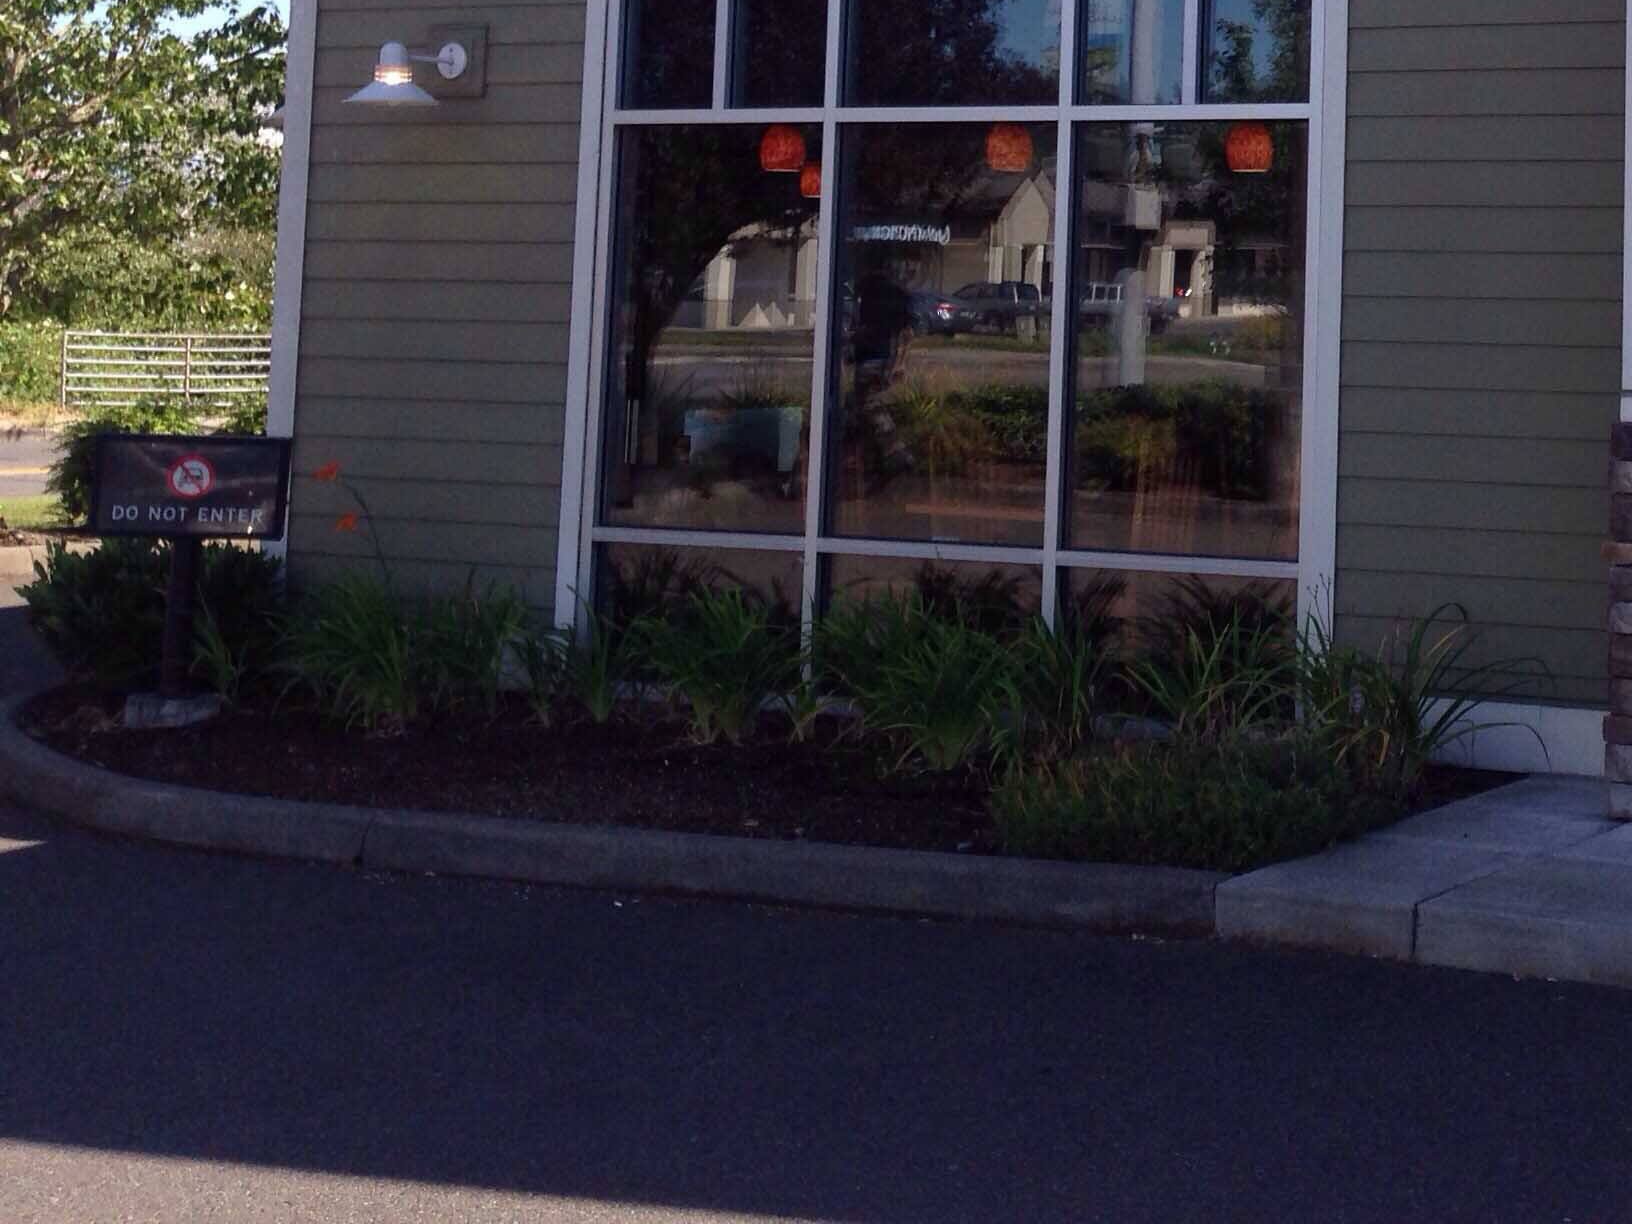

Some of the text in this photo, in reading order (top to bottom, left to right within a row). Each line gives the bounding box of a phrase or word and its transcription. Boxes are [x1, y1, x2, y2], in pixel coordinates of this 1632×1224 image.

[111, 504, 264, 524] DO NOT ENTER
